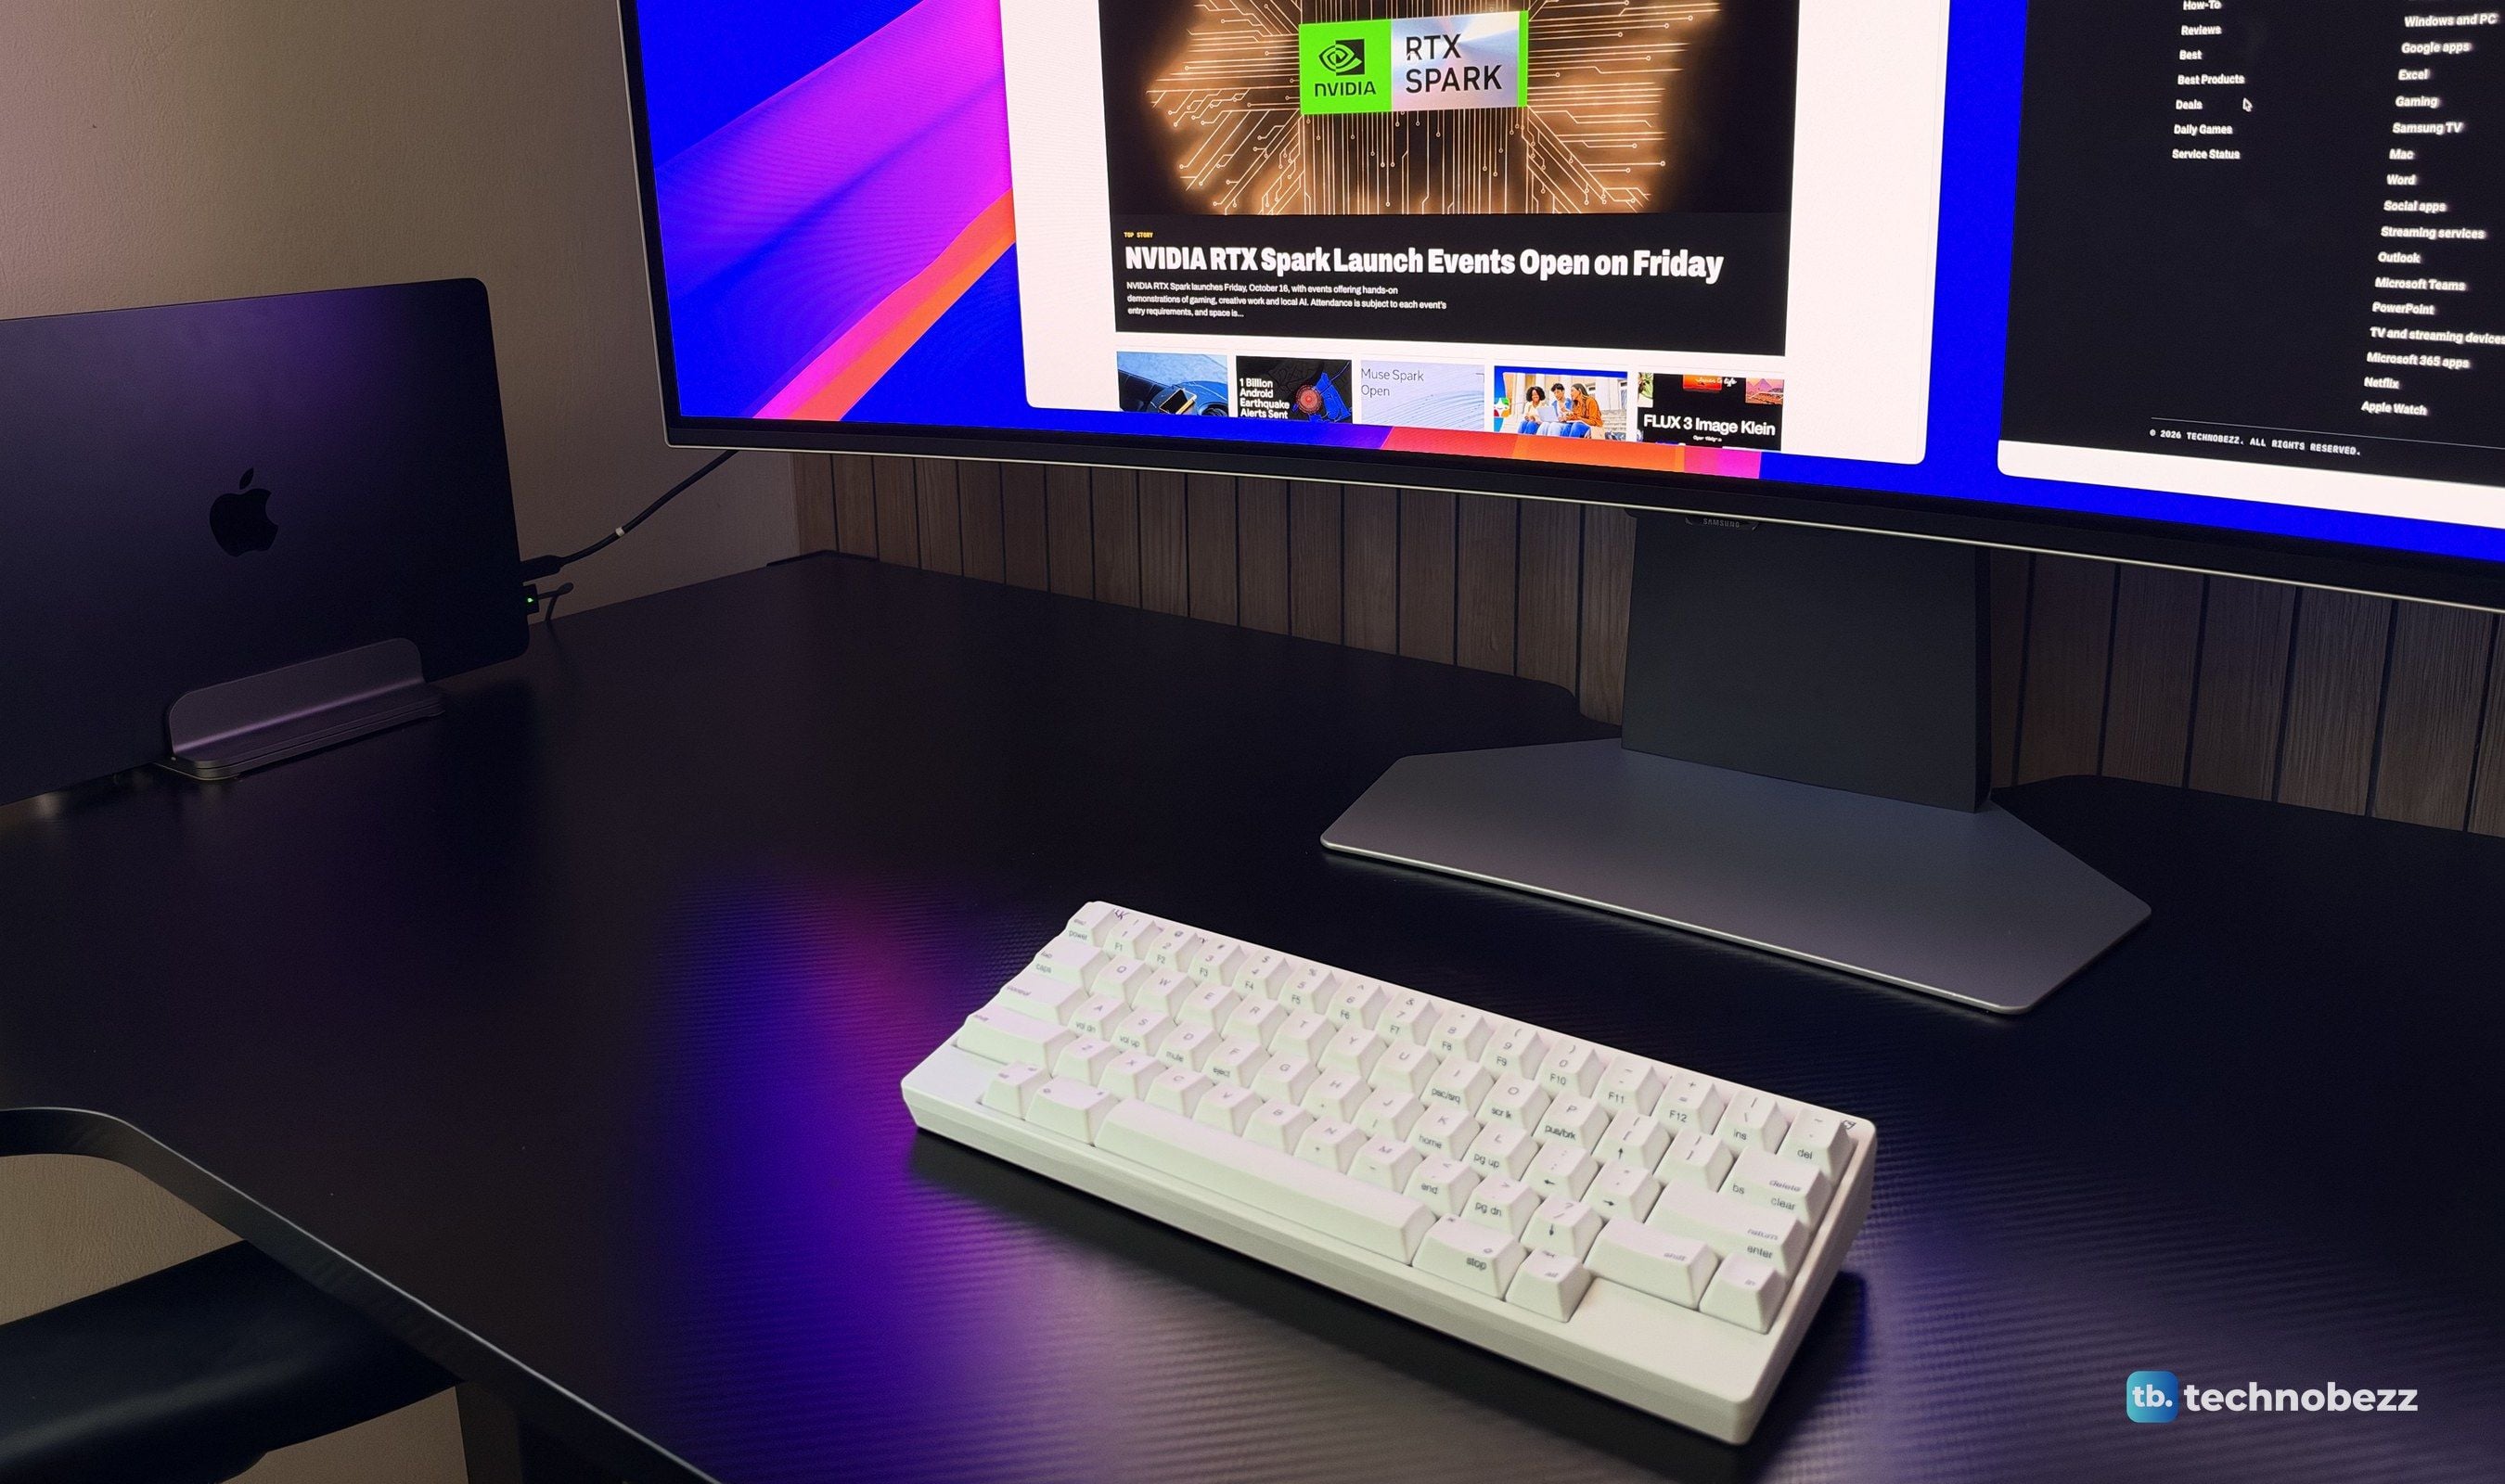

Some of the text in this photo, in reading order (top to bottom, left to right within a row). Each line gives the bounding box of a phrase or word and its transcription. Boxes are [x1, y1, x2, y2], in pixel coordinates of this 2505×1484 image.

[2183, 0, 2222, 11] How-To
[2404, 12, 2499, 28] Windows and PC
[2181, 24, 2222, 36] Reviews
[1405, 33, 1462, 61] RTX
[2401, 42, 2474, 55] Google apps
[2179, 49, 2203, 60] Best
[1405, 65, 1503, 94] SPARK
[2177, 73, 2245, 85] Best Products
[2398, 69, 2430, 81] Excel
[2176, 99, 2203, 110] Deals
[2396, 96, 2440, 109] Gaming
[2174, 124, 2233, 136] Daily Games
[2392, 122, 2465, 135] Samsung TV
[2172, 149, 2241, 160] Service Status
[2389, 148, 2415, 160] Mac
[2386, 173, 2418, 186] Word
[2383, 200, 2447, 213] Social apps
[2381, 225, 2486, 240] Streaming services
[2378, 251, 2422, 263] Outlook
[1124, 246, 1725, 285] NVIDIA RTX Spark Launch Events Open on Friday
[1126, 282, 1153, 290] NVIDIA
[1153, 282, 1169, 290] RTX
[1170, 283, 1191, 292] Spark
[1191, 283, 1224, 292] launches
[1224, 283, 1248, 293] Friday,
[1249, 284, 1278, 293] October
[1291, 285, 1307, 293] with
[1307, 285, 1332, 294] events
[1333, 285, 1362, 296] offering
[1362, 286, 1399, 295] hands-on
[2375, 276, 2467, 291] Microsoft Teams
[1126, 294, 1447, 310] demonstrations of gaming, creative work and local AI. Attendance is subject to each event's
[2371, 301, 2435, 315] PowerPoint
[1127, 307, 1244, 317] entry requirements, and space is...
[2370, 326, 2505, 345] TV and streaming devices
[2366, 352, 2472, 370] Microsoft 365 apps
[1361, 367, 1424, 384] Muse Spark
[1240, 377, 1274, 389] 1 Billion
[2364, 377, 2400, 390] Netflix
[1240, 388, 1274, 399] Android
[1361, 384, 1391, 399] Open
[1240, 397, 1291, 410] Earthquake
[2360, 401, 2429, 416] Apple Watch
[1240, 408, 1289, 419] Alerts Sent
[1643, 414, 1776, 436] FLUX 3 Image Klein
[2160, 429, 2182, 440] 2026
[2187, 431, 2244, 445] TECHNOBEZZ.
[2249, 437, 2267, 447] ALL
[2271, 439, 2305, 451] RIGHTS
[2309, 442, 2361, 456] RESERVED.
[1702, 518, 1741, 529] SAMSUNG
[1549, 1073, 1567, 1086] F10
[1608, 1092, 1625, 1104] F11
[1669, 1109, 1688, 1123] F12
[1419, 1134, 1443, 1149] home
[1796, 1147, 1813, 1160] del
[1770, 1196, 1796, 1211] clear
[1746, 1245, 1774, 1260] enter
